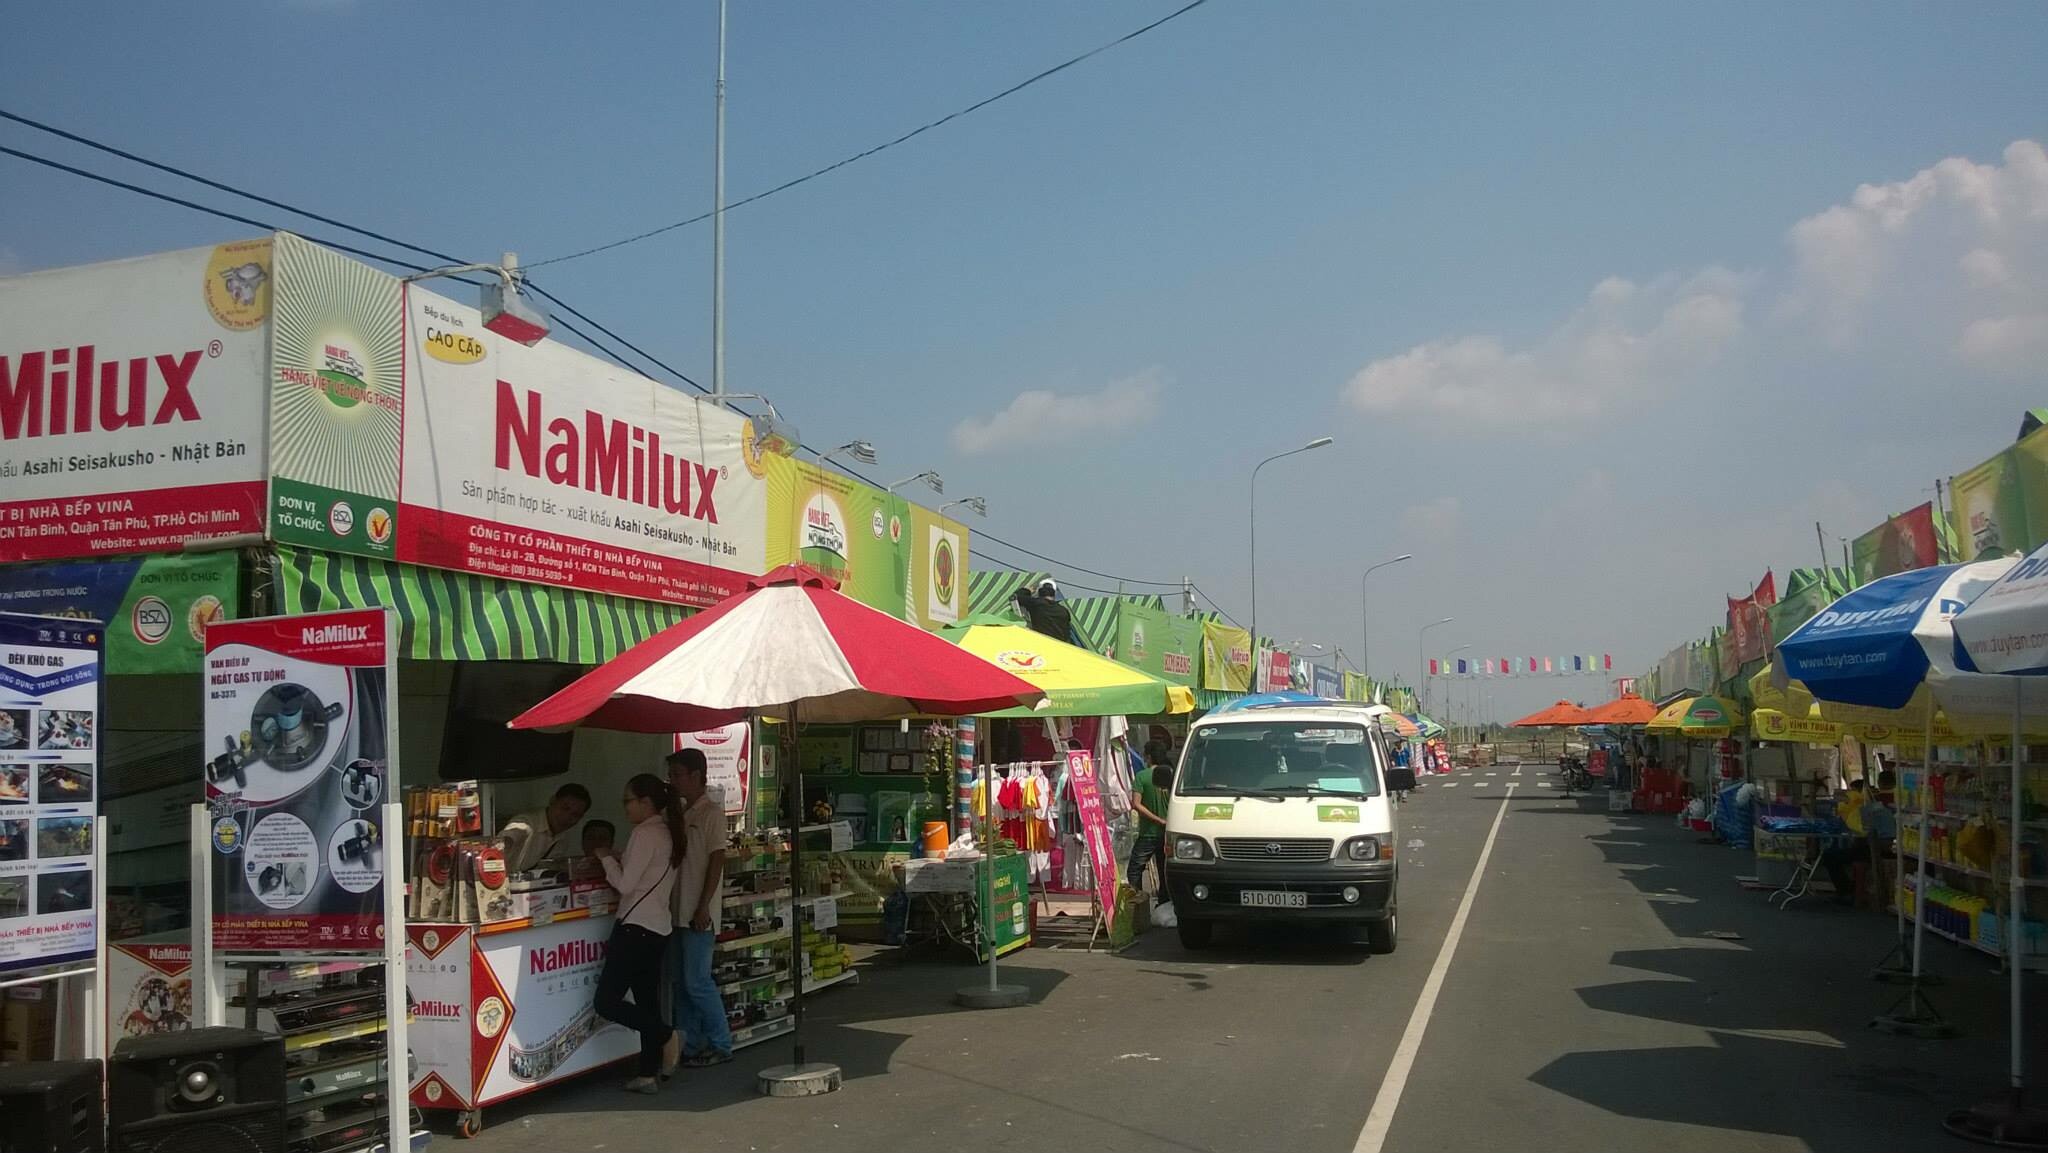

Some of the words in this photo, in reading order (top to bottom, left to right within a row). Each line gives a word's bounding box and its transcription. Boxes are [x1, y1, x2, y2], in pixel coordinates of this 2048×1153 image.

[440, 312, 449, 322] du
[426, 327, 454, 348] CAO
[458, 337, 483, 357] CẤP
[280, 365, 309, 386] HÀNG
[312, 374, 331, 391] VIỆT
[23, 457, 63, 476] Asahi
[68, 449, 154, 472] Seisakusho
[172, 446, 210, 464] Nhật
[215, 439, 246, 457] Bản
[495, 379, 719, 524] NaMilux
[11, 507, 24, 522] BỊ
[30, 502, 59, 519] NHÀ
[65, 498, 92, 516] BẾP
[97, 499, 133, 513] VINA
[279, 495, 303, 509] ĐƠN
[304, 501, 316, 515] VỊ
[18, 525, 38, 538] Tân
[71, 519, 99, 534] Quận
[102, 518, 123, 532] Tân
[189, 510, 209, 525] Chí
[211, 508, 240, 521] Minh
[294, 516, 325, 532] CHỨC:
[462, 480, 482, 498] Sản
[520, 493, 538, 513] hợp
[542, 499, 556, 515] tác
[567, 506, 587, 522] xuất
[614, 515, 641, 535] Asahi
[643, 522, 694, 546] Seisakusho
[701, 536, 720, 554] Nhật
[722, 541, 737, 556] Bản
[91, 536, 136, 550] Website:
[470, 525, 501, 541] CÔNG
[503, 532, 516, 543] TY
[519, 533, 534, 547] CỔ
[536, 536, 562, 552] PHẦN
[566, 543, 592, 558] THIẾT
[594, 549, 602, 562] BỊ
[605, 551, 623, 564] NHÀ
[626, 554, 641, 567] BẾP
[643, 559, 663, 571] VINA
[468, 557, 486, 569] Điện
[469, 542, 483, 556] Địa
[501, 548, 512, 559] Lô
[582, 562, 598, 574] KCN
[141, 573, 161, 584] ĐƠN
[42, 588, 64, 597] TRONG
[140, 610, 167, 624] BSA
[302, 624, 368, 645] NaMilux
[8, 652, 26, 665] ĐÈN
[47, 655, 64, 668] GAS
[211, 659, 224, 668] VAN
[1799, 652, 1888, 670] www.duytan.com
[15, 678, 35, 691] DỤNG
[36, 677, 59, 690] TRONG
[234, 672, 250, 683] GAS
[16, 926, 35, 938] THIẾT
[44, 924, 60, 936] NHÀ
[75, 920, 93, 930] VINA
[294, 920, 308, 928] VINA
[413, 1001, 461, 1017] aMilux
